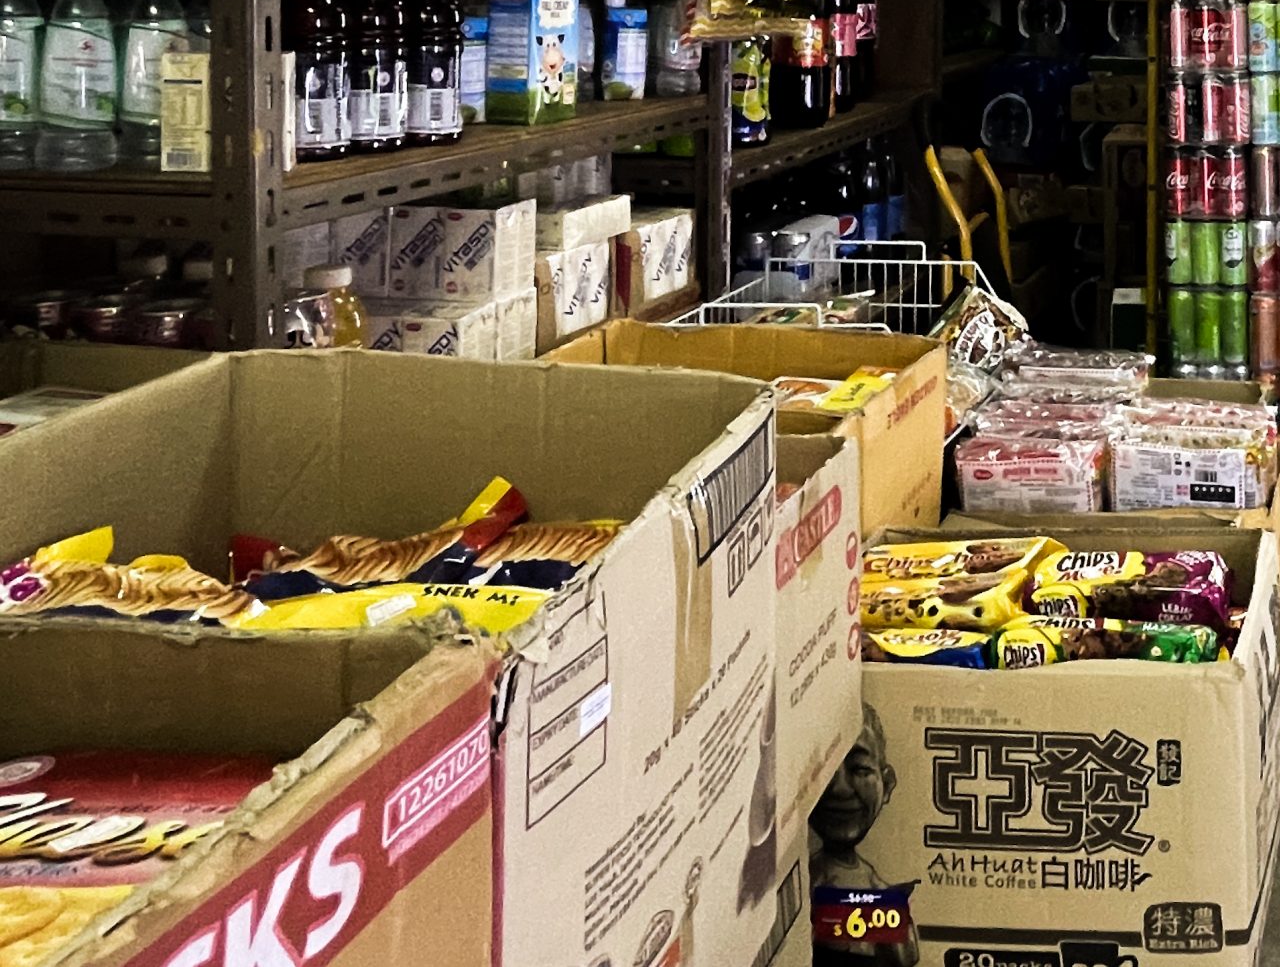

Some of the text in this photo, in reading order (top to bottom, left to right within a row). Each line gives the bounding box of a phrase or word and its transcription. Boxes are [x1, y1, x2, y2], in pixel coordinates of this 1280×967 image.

[1057, 551, 1115, 572] Chips
[423, 584, 478, 600] SNEK
[927, 852, 1153, 892] Ah Huat 白咖啡
[928, 872, 1038, 890] White Coffee
[1148, 938, 1218, 950] Extra Rich
